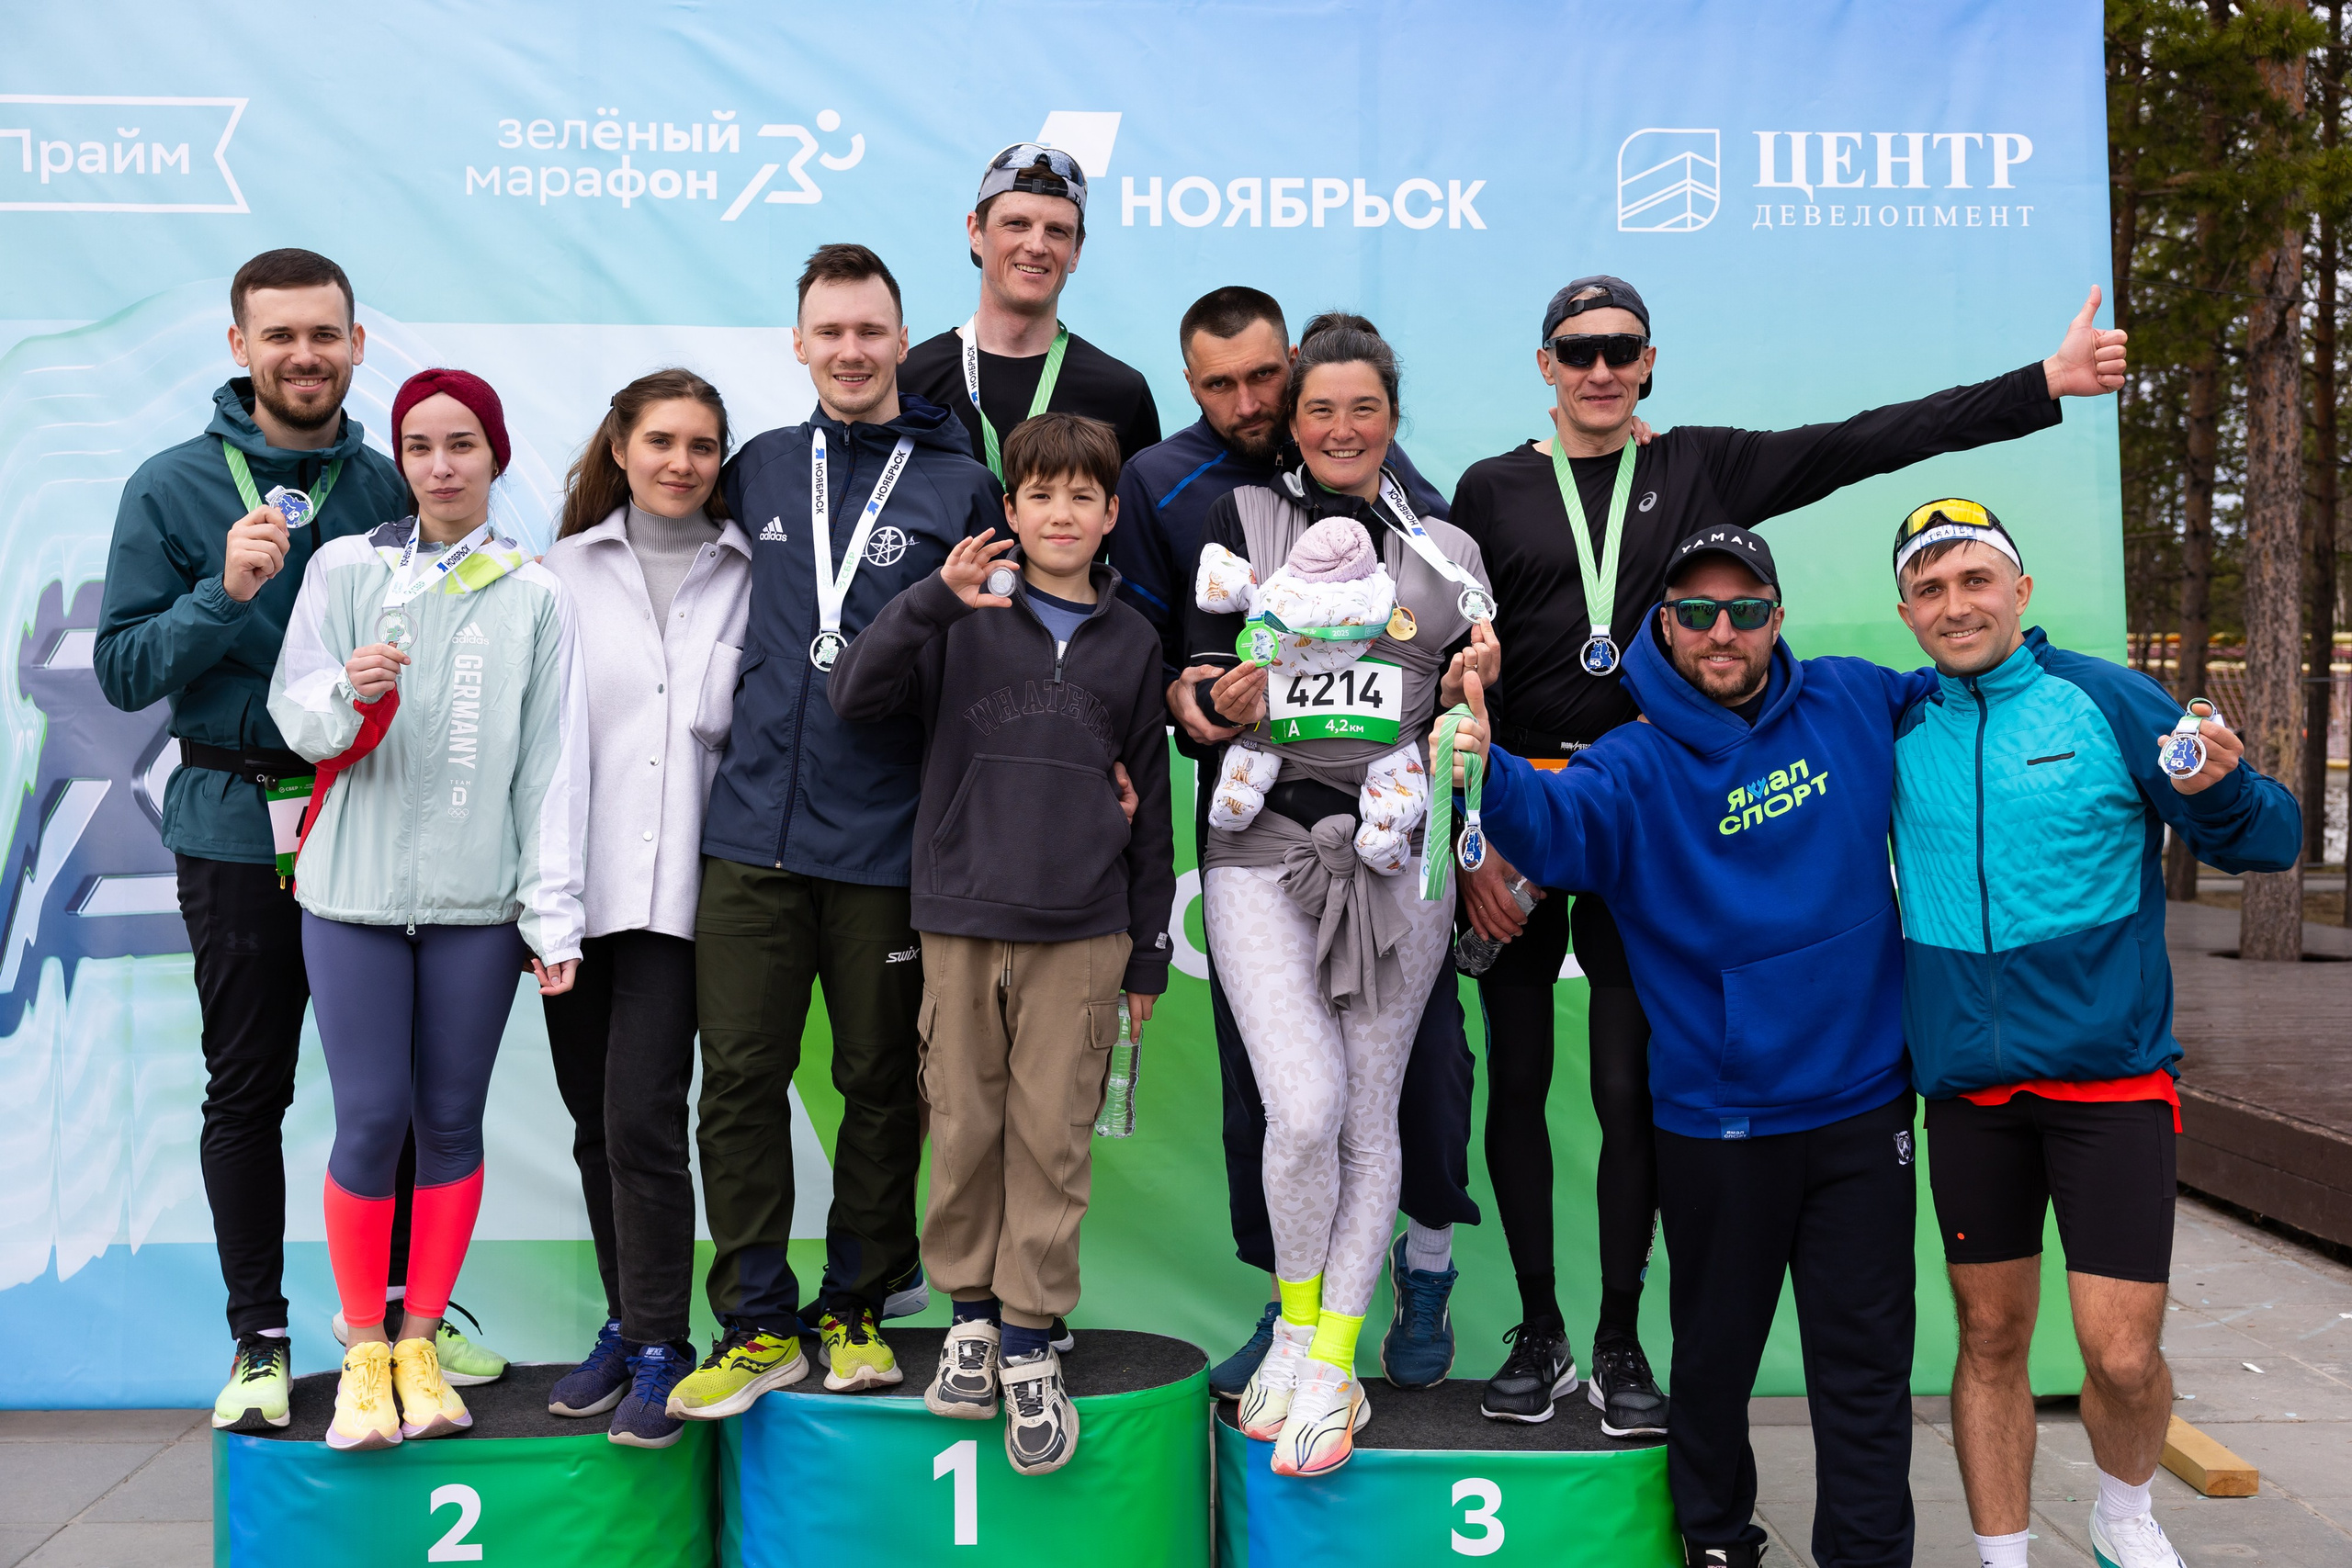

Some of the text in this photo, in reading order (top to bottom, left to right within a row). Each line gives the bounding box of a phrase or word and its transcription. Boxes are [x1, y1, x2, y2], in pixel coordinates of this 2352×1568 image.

[498, 107, 740, 153] зелёный
[466, 154, 718, 209] марафон
[1753, 131, 2034, 190] ЦЕНТР
[1122, 175, 1487, 230] НОЯБРЬСК
[1752, 205, 2034, 230] ДЕВЕЛОПМЕНТ
[967, 344, 978, 389] НОЯБРЬСК
[815, 462, 825, 514] НОЯБРЬСК
[875, 449, 907, 502] НОЯБРЬСК
[1386, 488, 1419, 526] НОЯБРЬСК
[444, 544, 471, 568] НОЯБРЬСК
[759, 531, 787, 542] adidas
[1680, 532, 1758, 554] YAMAL
[842, 551, 855, 579] СБЕР
[451, 635, 490, 645] adidas
[1332, 629, 1350, 637] 2025
[447, 653, 484, 770] GERMANY
[1286, 670, 1384, 708] 4214
[1718, 771, 1828, 836] СПОРТ
[933, 1440, 978, 1545] 1
[428, 1483, 482, 1562] 2
[1451, 1477, 1505, 1556] 3
